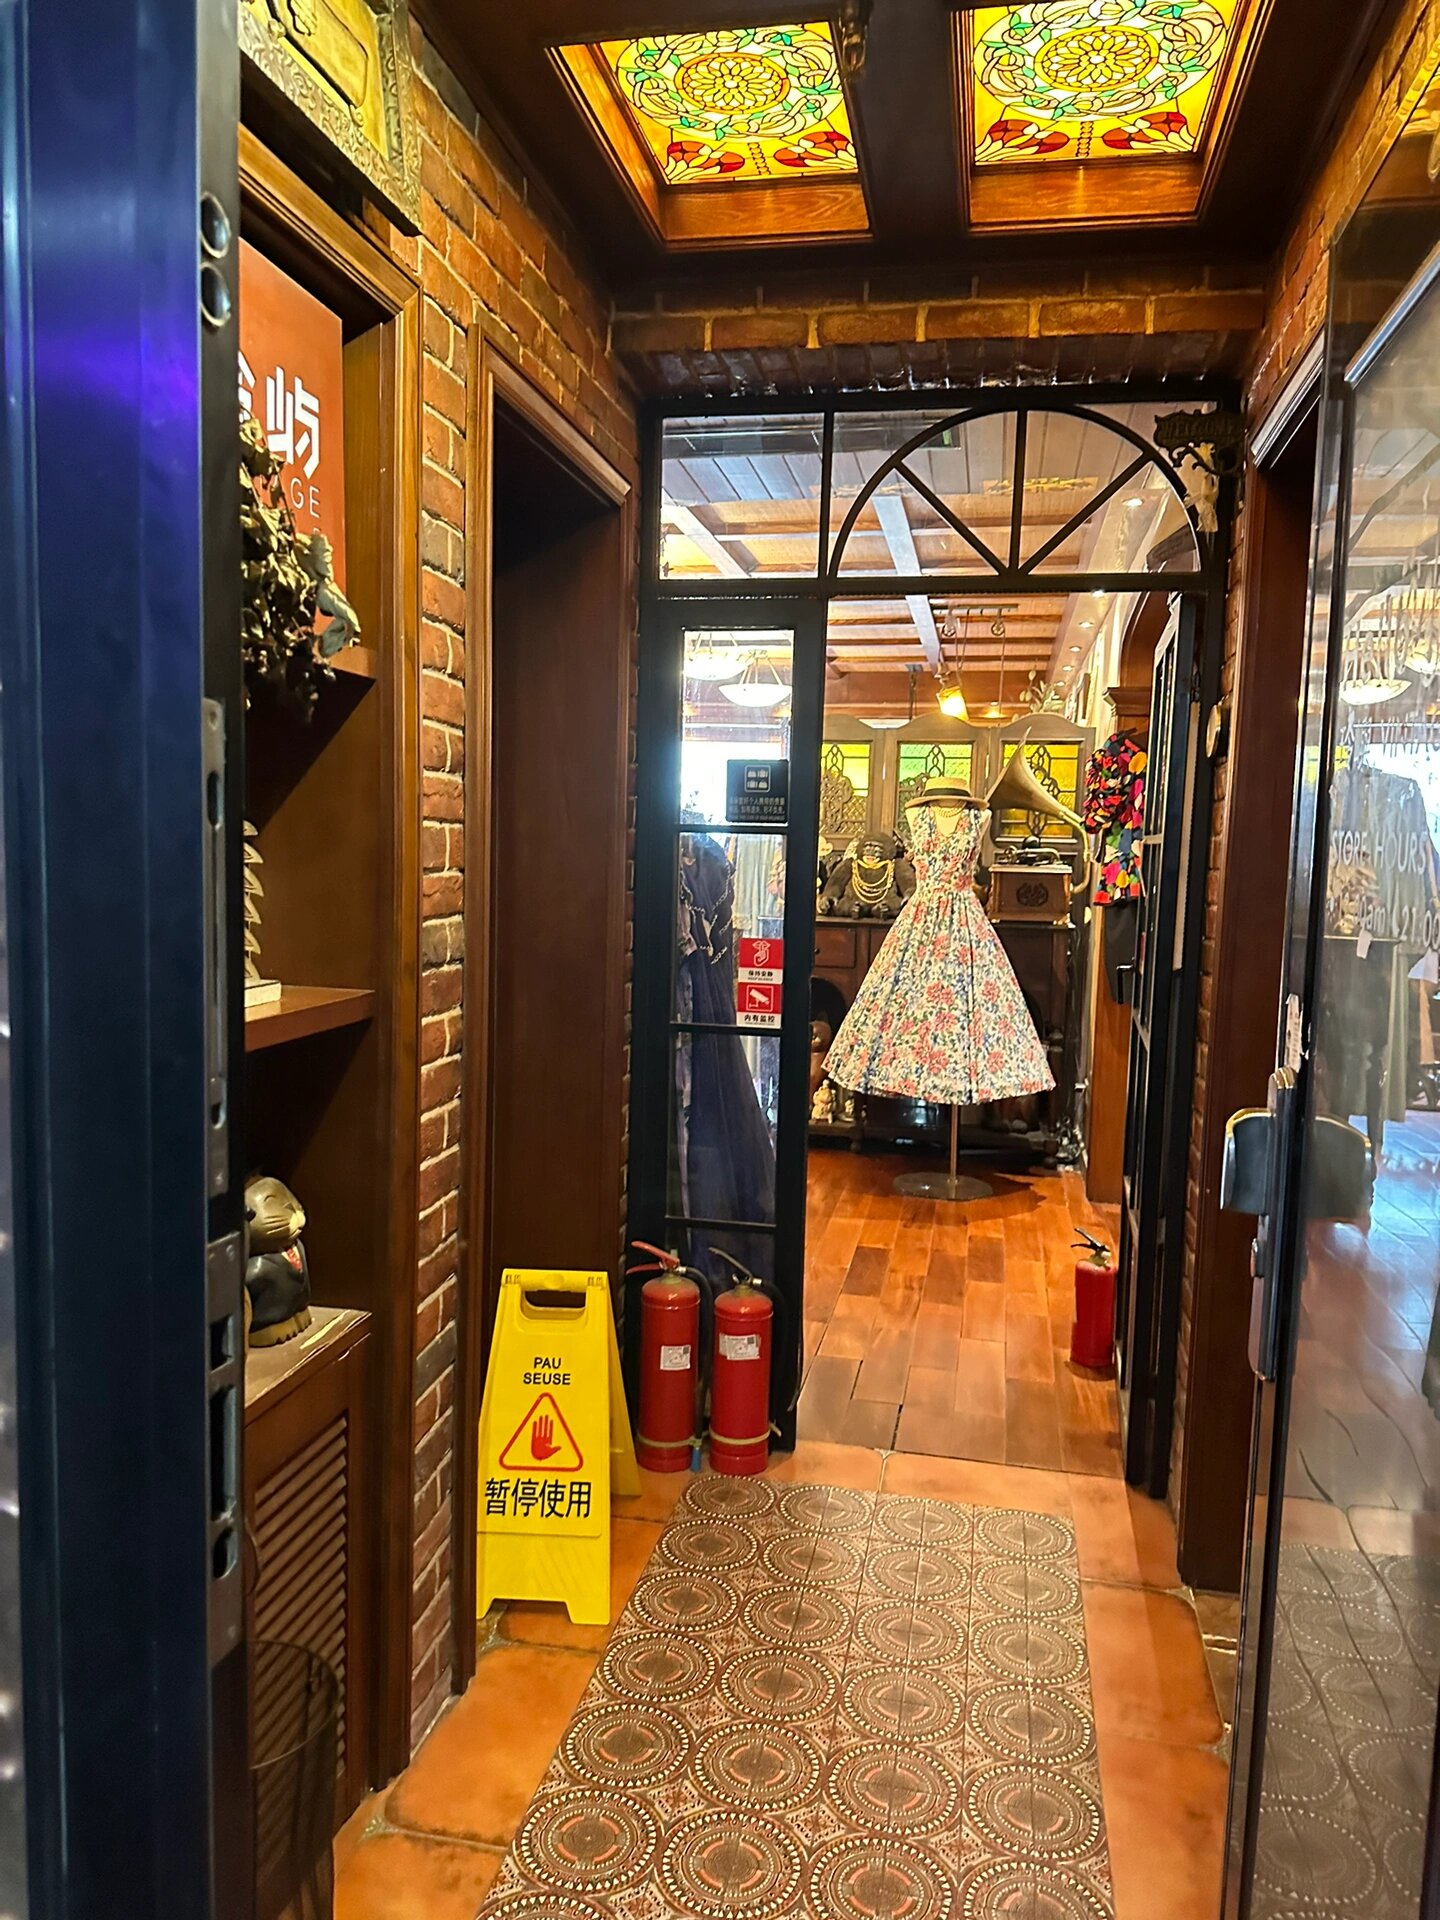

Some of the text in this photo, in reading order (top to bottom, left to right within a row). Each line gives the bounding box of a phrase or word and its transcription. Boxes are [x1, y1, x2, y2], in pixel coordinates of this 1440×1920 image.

[1332, 830, 1427, 874] STORE HOURS
[744, 1014, 775, 1023] 内有监控
[534, 1357, 561, 1369] PAU
[523, 1372, 571, 1385] SEUSE
[485, 1478, 592, 1519] 暂停使用
